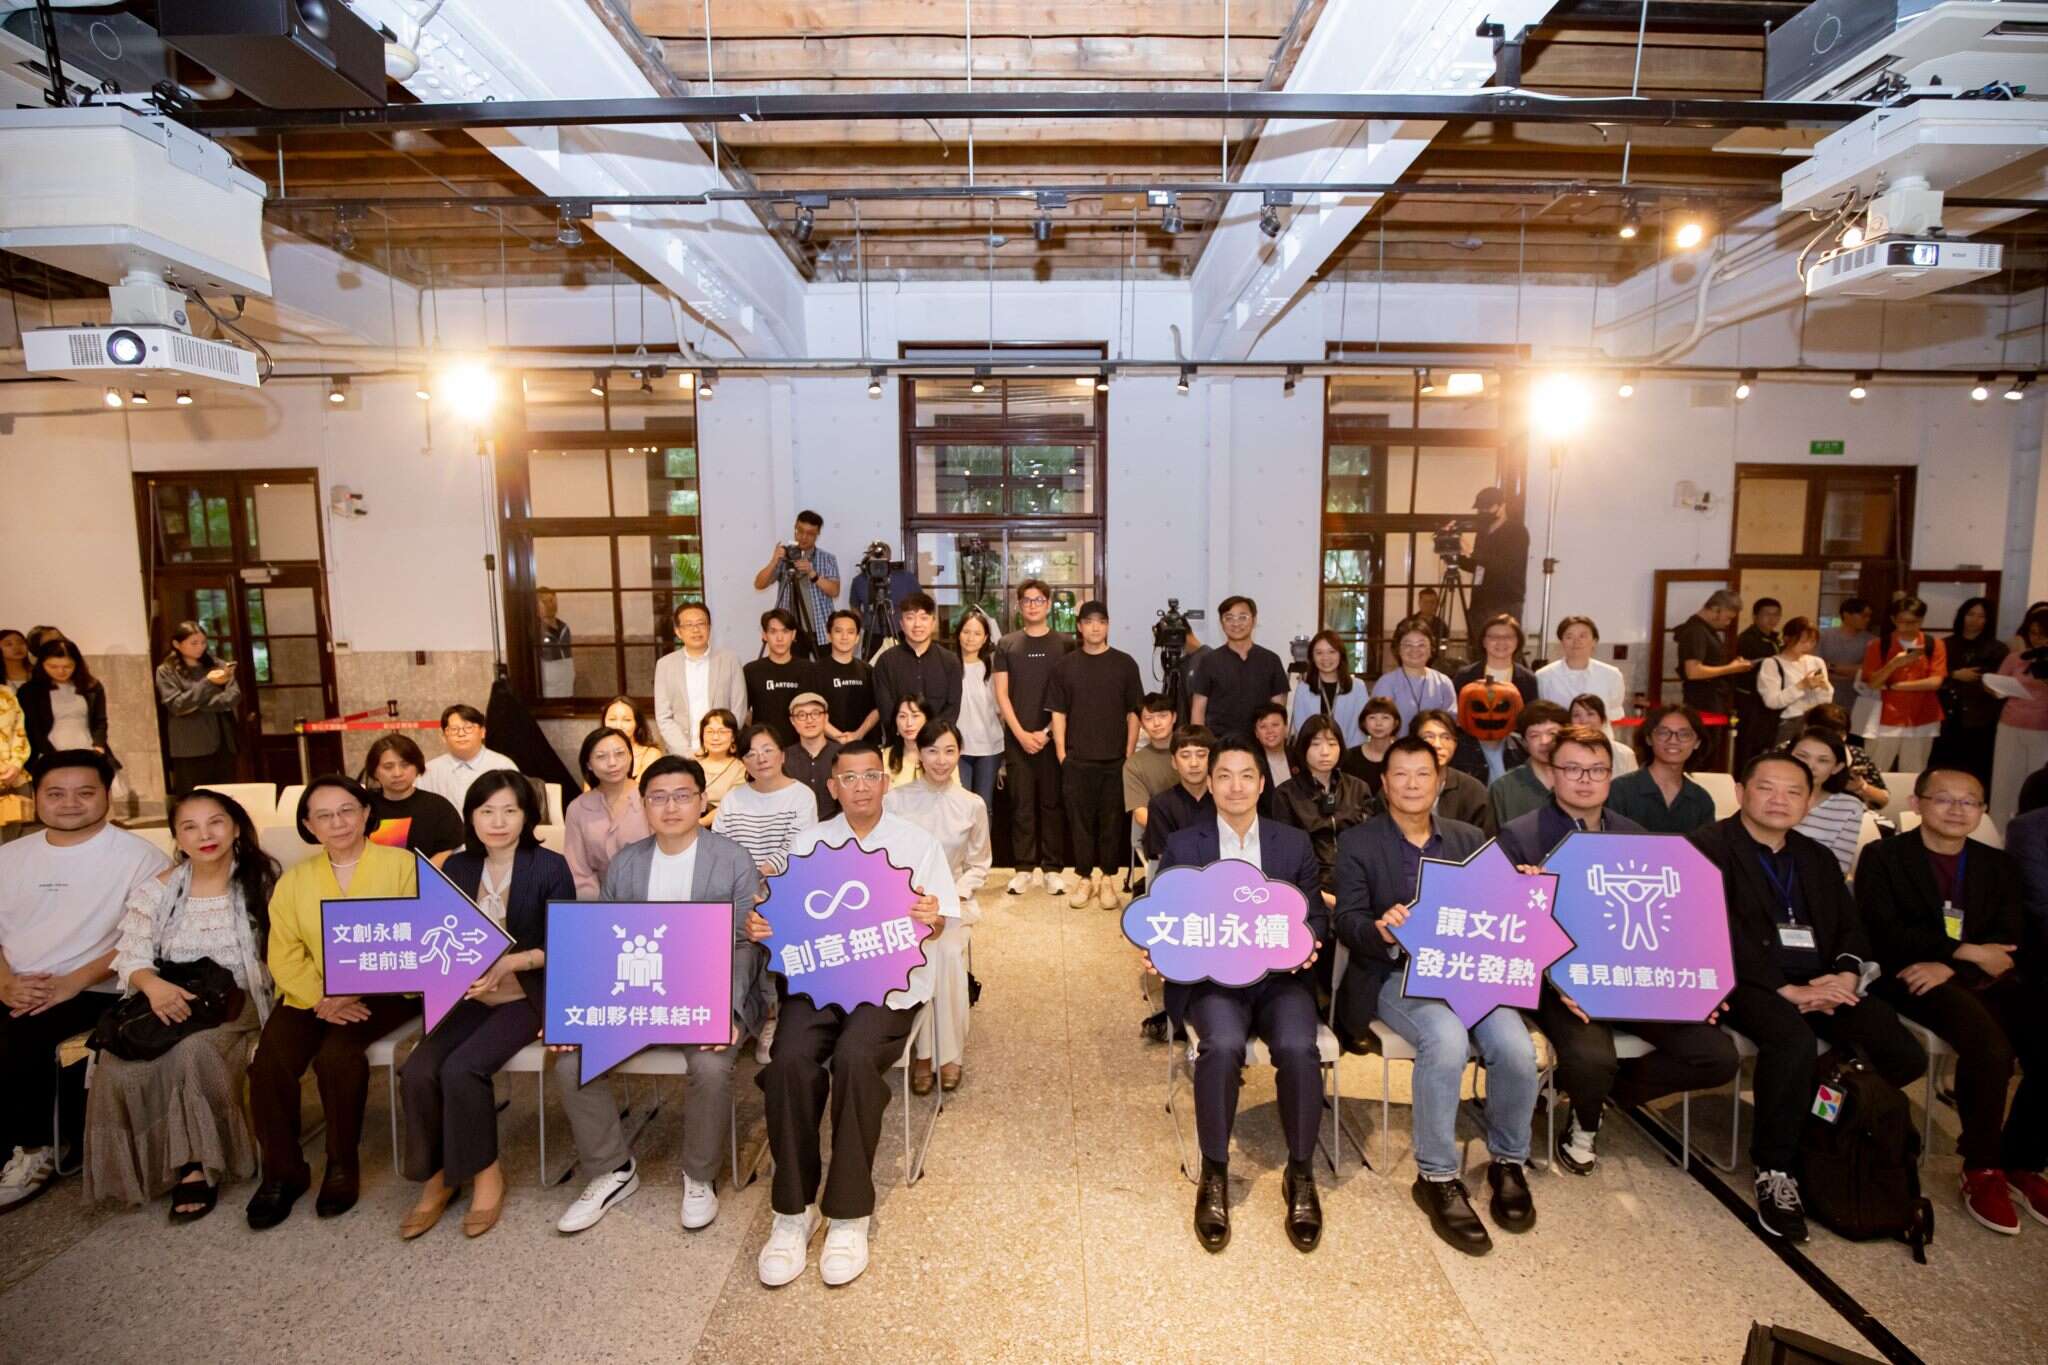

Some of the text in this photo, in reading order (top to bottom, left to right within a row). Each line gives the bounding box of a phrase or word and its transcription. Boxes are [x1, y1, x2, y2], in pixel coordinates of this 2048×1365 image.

[332, 922, 412, 944] 文創永續
[1146, 911, 1290, 949] 文創永續
[1435, 906, 1527, 943] 讓文化
[338, 950, 418, 972] 一起前進
[780, 916, 921, 977] 創意無限
[1416, 947, 1537, 988] 發光發熱
[1568, 963, 1720, 990] 看見創意的力量
[564, 1005, 712, 1027] 文創夥伴集結中
